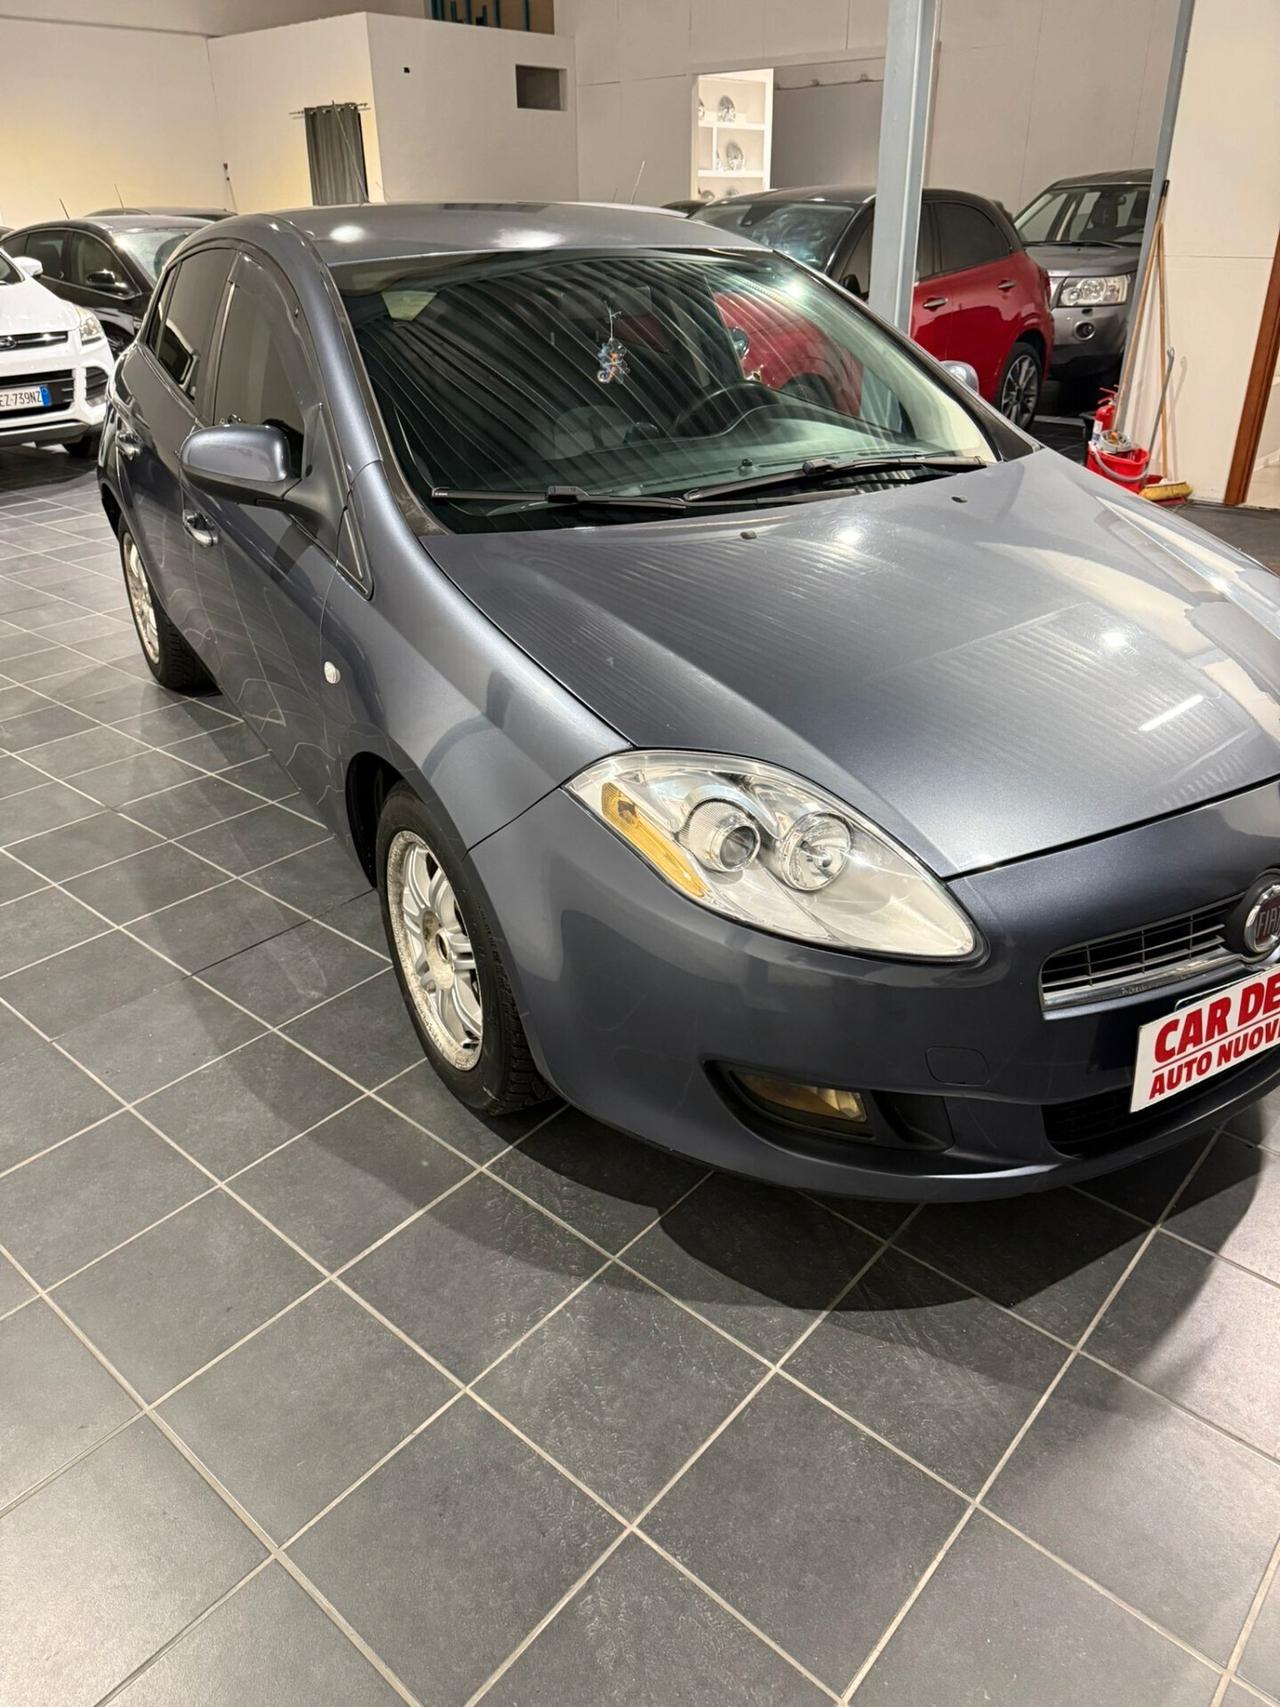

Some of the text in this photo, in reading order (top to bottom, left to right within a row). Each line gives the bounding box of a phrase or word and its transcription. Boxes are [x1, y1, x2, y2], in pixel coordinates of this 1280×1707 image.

[1148, 1018, 1280, 1100] AUTO NUOV
[1154, 996, 1232, 1063] CAR
